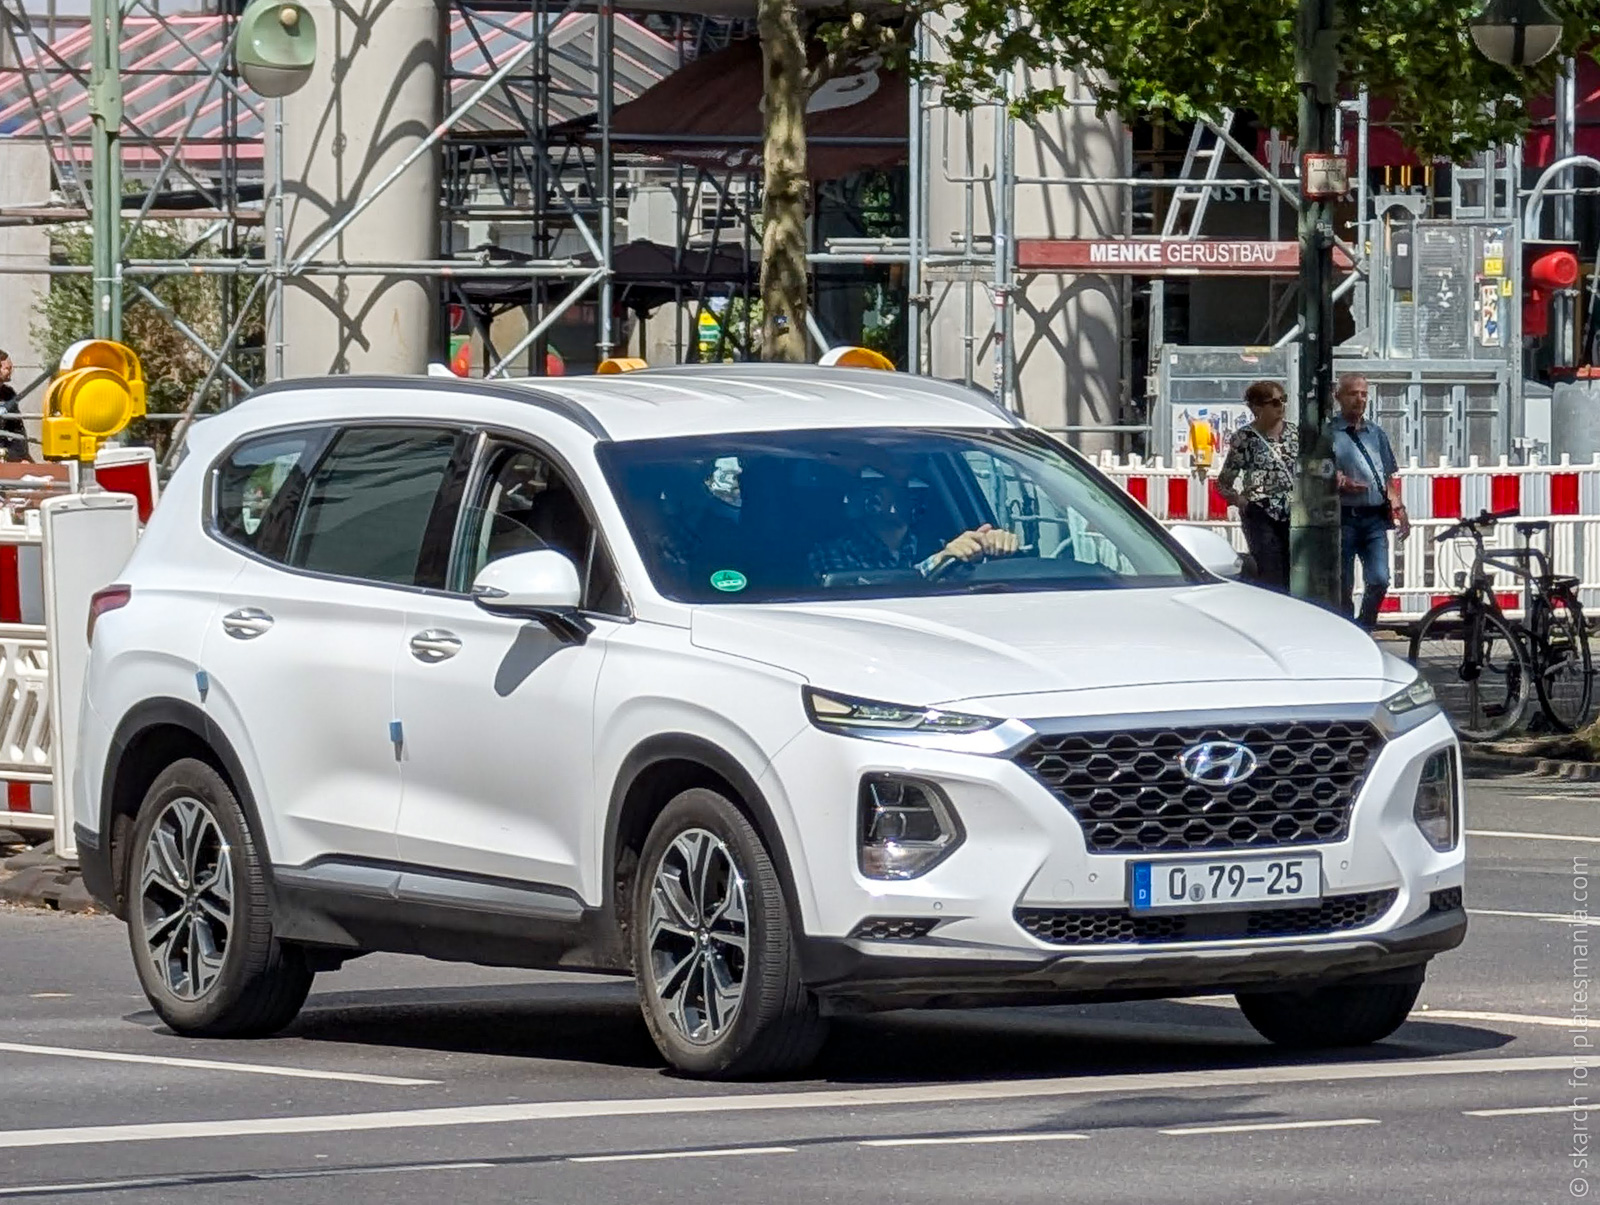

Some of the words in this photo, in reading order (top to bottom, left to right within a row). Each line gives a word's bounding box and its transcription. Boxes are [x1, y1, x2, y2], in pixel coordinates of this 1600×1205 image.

[1090, 243, 1162, 263] MENKE
[1167, 243, 1276, 263] GERÜSTBAU
[1208, 861, 1303, 898] 79-25
[1138, 888, 1147, 900] D
